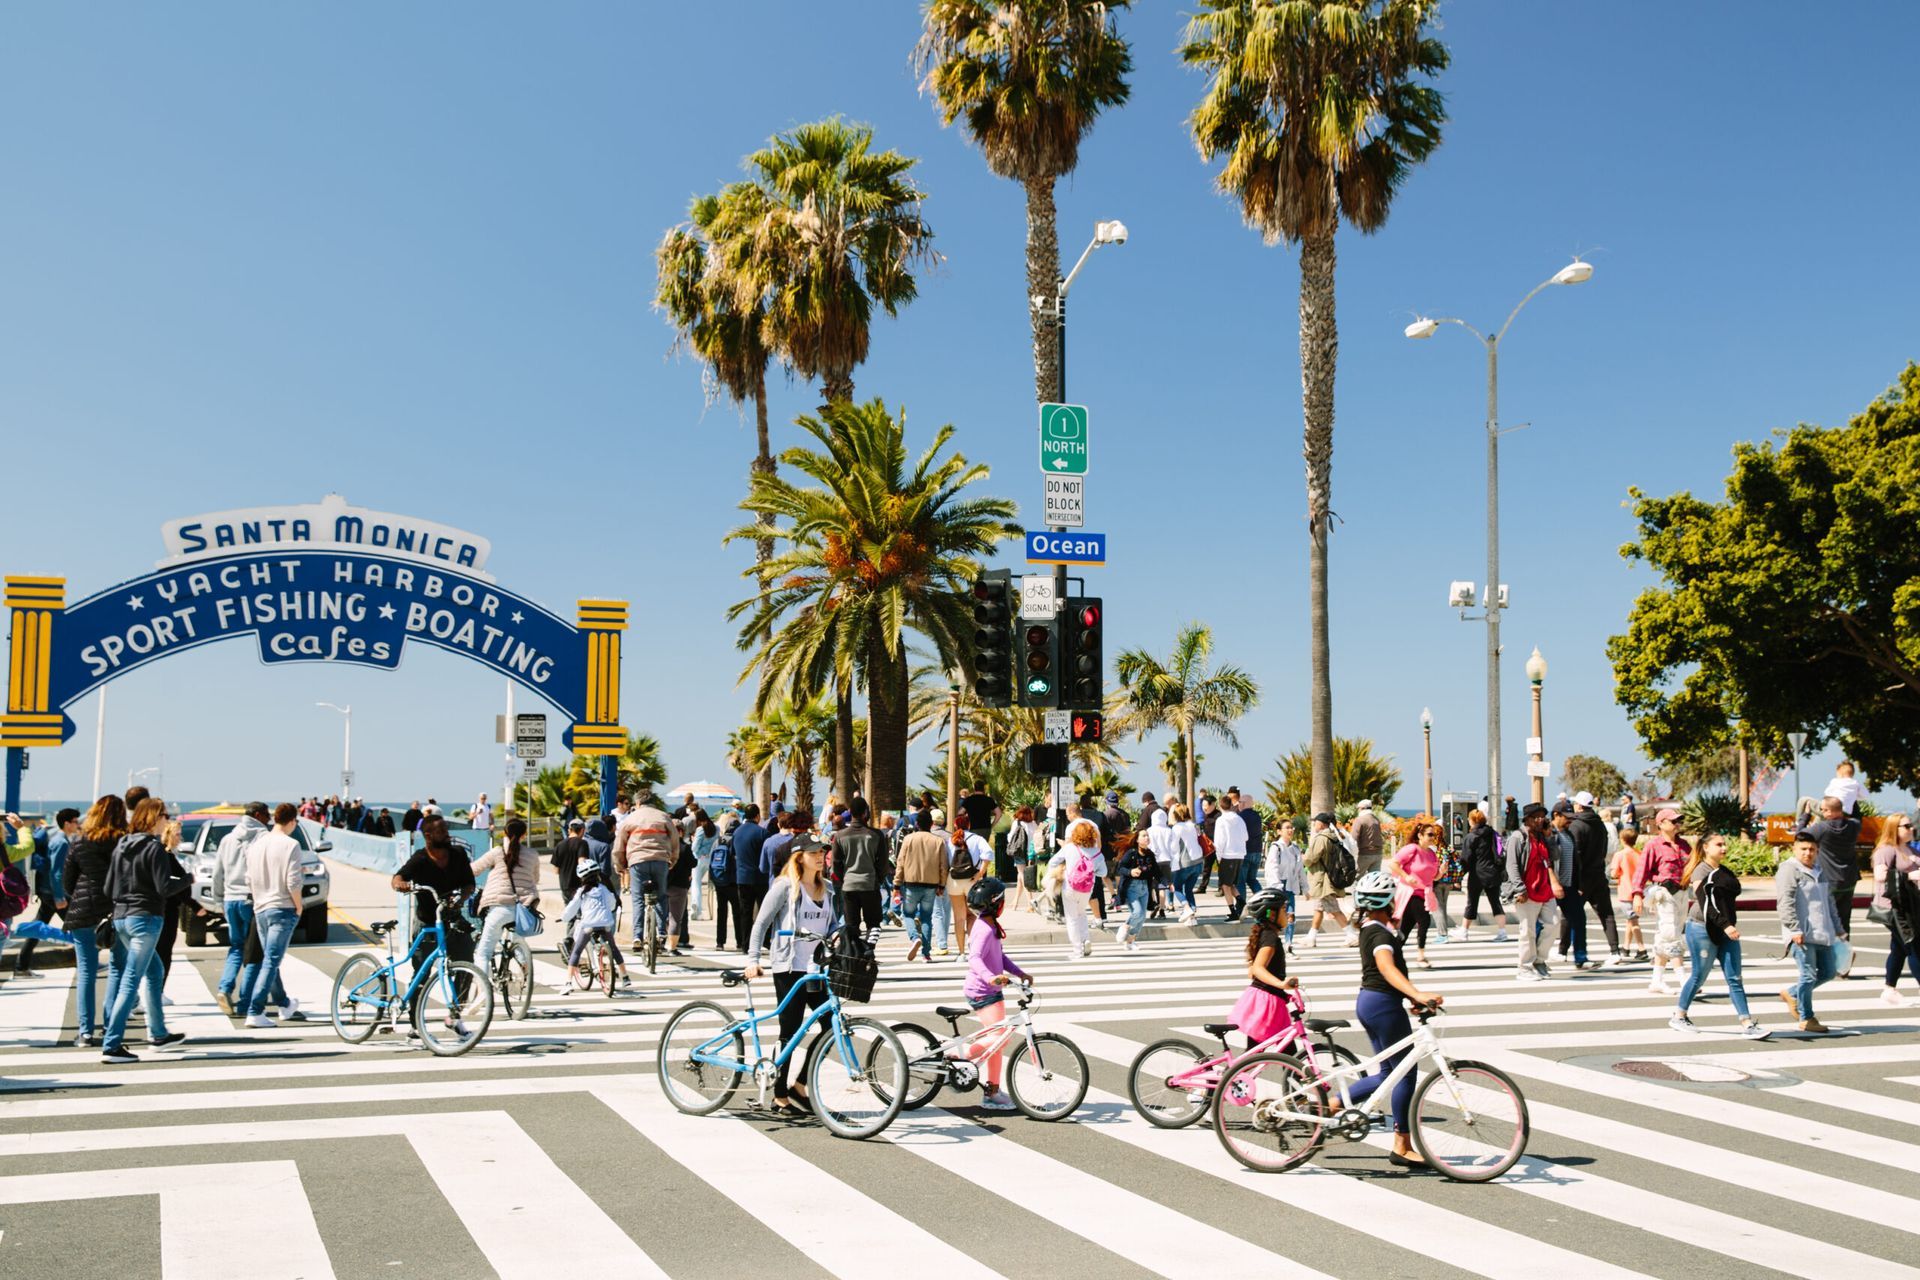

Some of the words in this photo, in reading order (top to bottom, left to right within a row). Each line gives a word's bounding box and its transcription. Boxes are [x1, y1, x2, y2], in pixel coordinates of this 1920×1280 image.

[1062, 417, 1067, 433] 1
[1043, 440, 1085, 454] NORTH
[1048, 481, 1060, 493] DO
[1063, 482, 1080, 494] NOT
[1048, 497, 1081, 511] BLOCK
[1047, 512, 1081, 522] INTERSECTION
[179, 519, 310, 554] SANTA
[335, 515, 478, 568] MONICA
[1032, 535, 1099, 555] Ocean
[156, 560, 301, 604] YACHT
[334, 561, 500, 618] HARBOR
[1025, 603, 1053, 613] SIGNAL
[80, 606, 197, 677] SPORT
[215, 591, 367, 629] FISHING
[405, 602, 555, 683] BOATING
[1046, 727, 1055, 740] OK
[526, 759, 536, 767] NO
